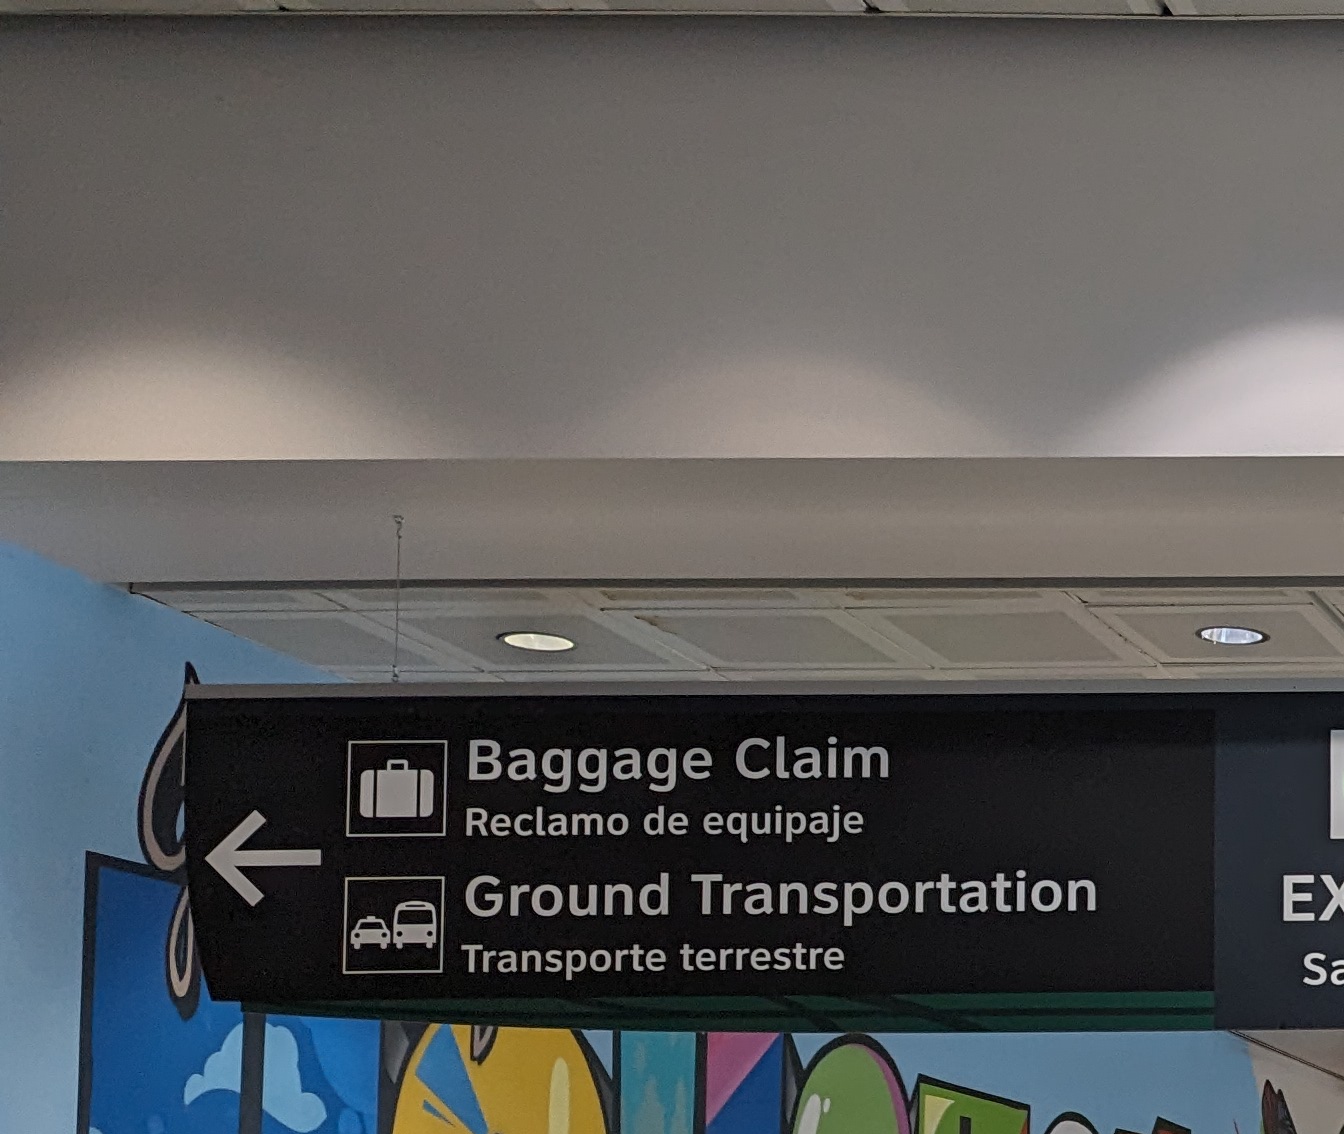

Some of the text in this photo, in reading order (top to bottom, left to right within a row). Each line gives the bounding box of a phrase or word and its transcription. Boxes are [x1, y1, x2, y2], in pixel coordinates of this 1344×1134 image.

[469, 736, 888, 794] Baggage Claim
[466, 805, 863, 843] Reclamo de equipaje
[466, 870, 1098, 926] Ground Transportation
[461, 942, 845, 979] Transporte terrestre
